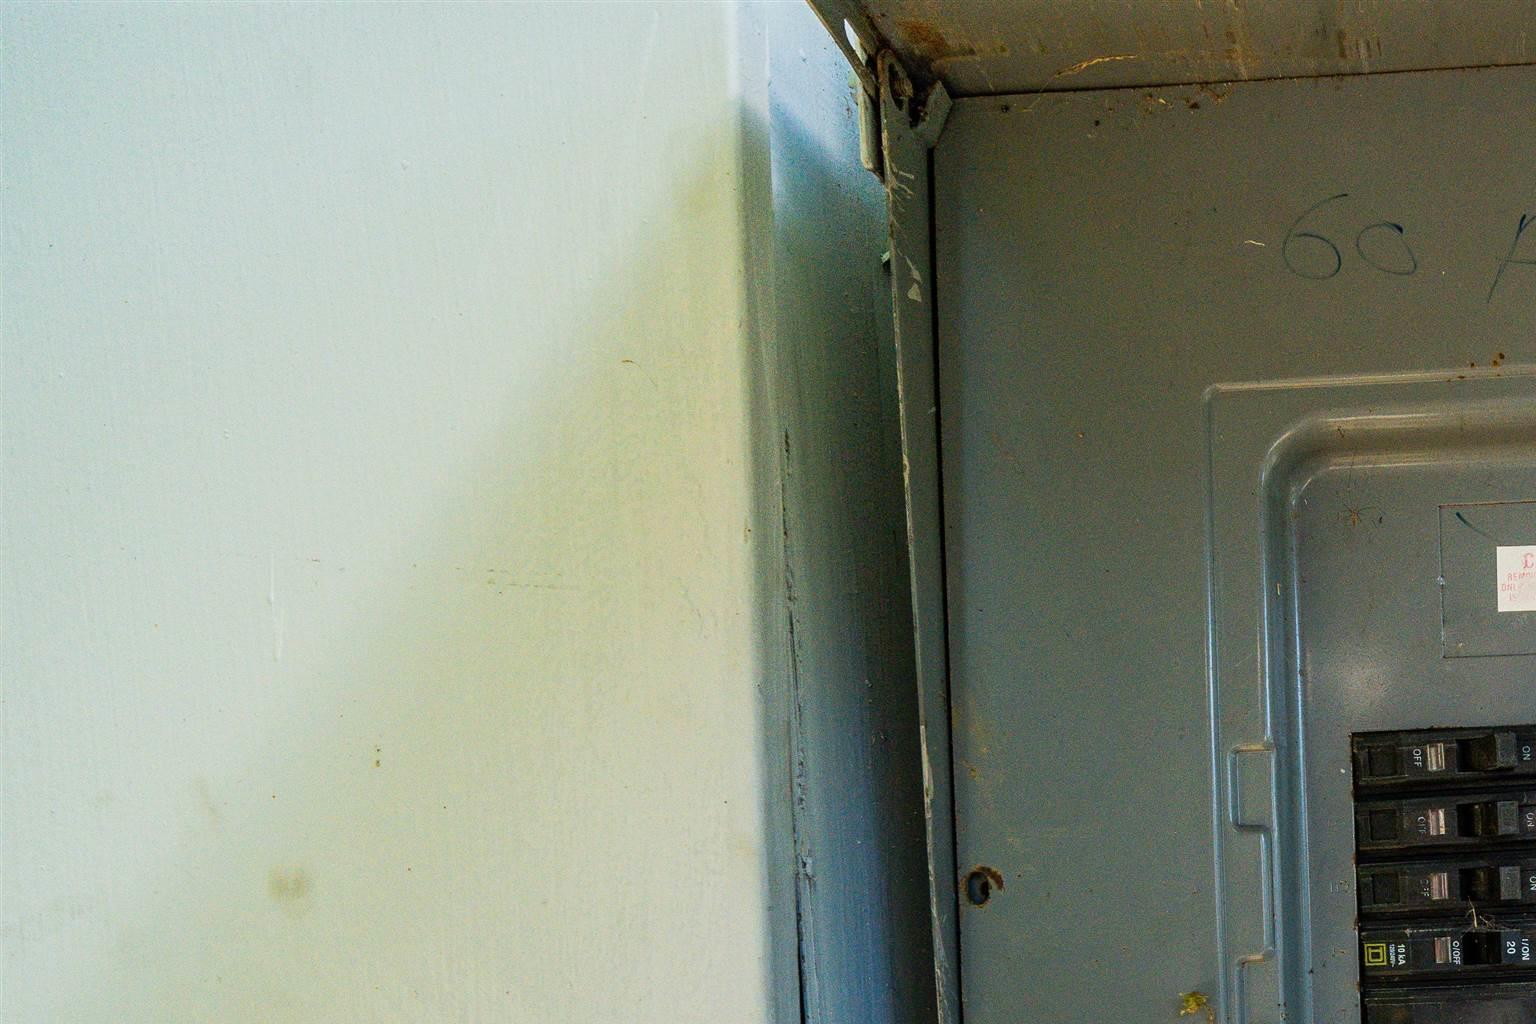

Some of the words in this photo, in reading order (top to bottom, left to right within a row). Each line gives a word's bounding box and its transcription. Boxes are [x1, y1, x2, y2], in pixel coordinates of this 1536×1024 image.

[1283, 193, 1417, 280] 60
[1412, 748, 1423, 768] OFF
[1521, 745, 1531, 761] ON
[1506, 941, 1515, 954] 20
